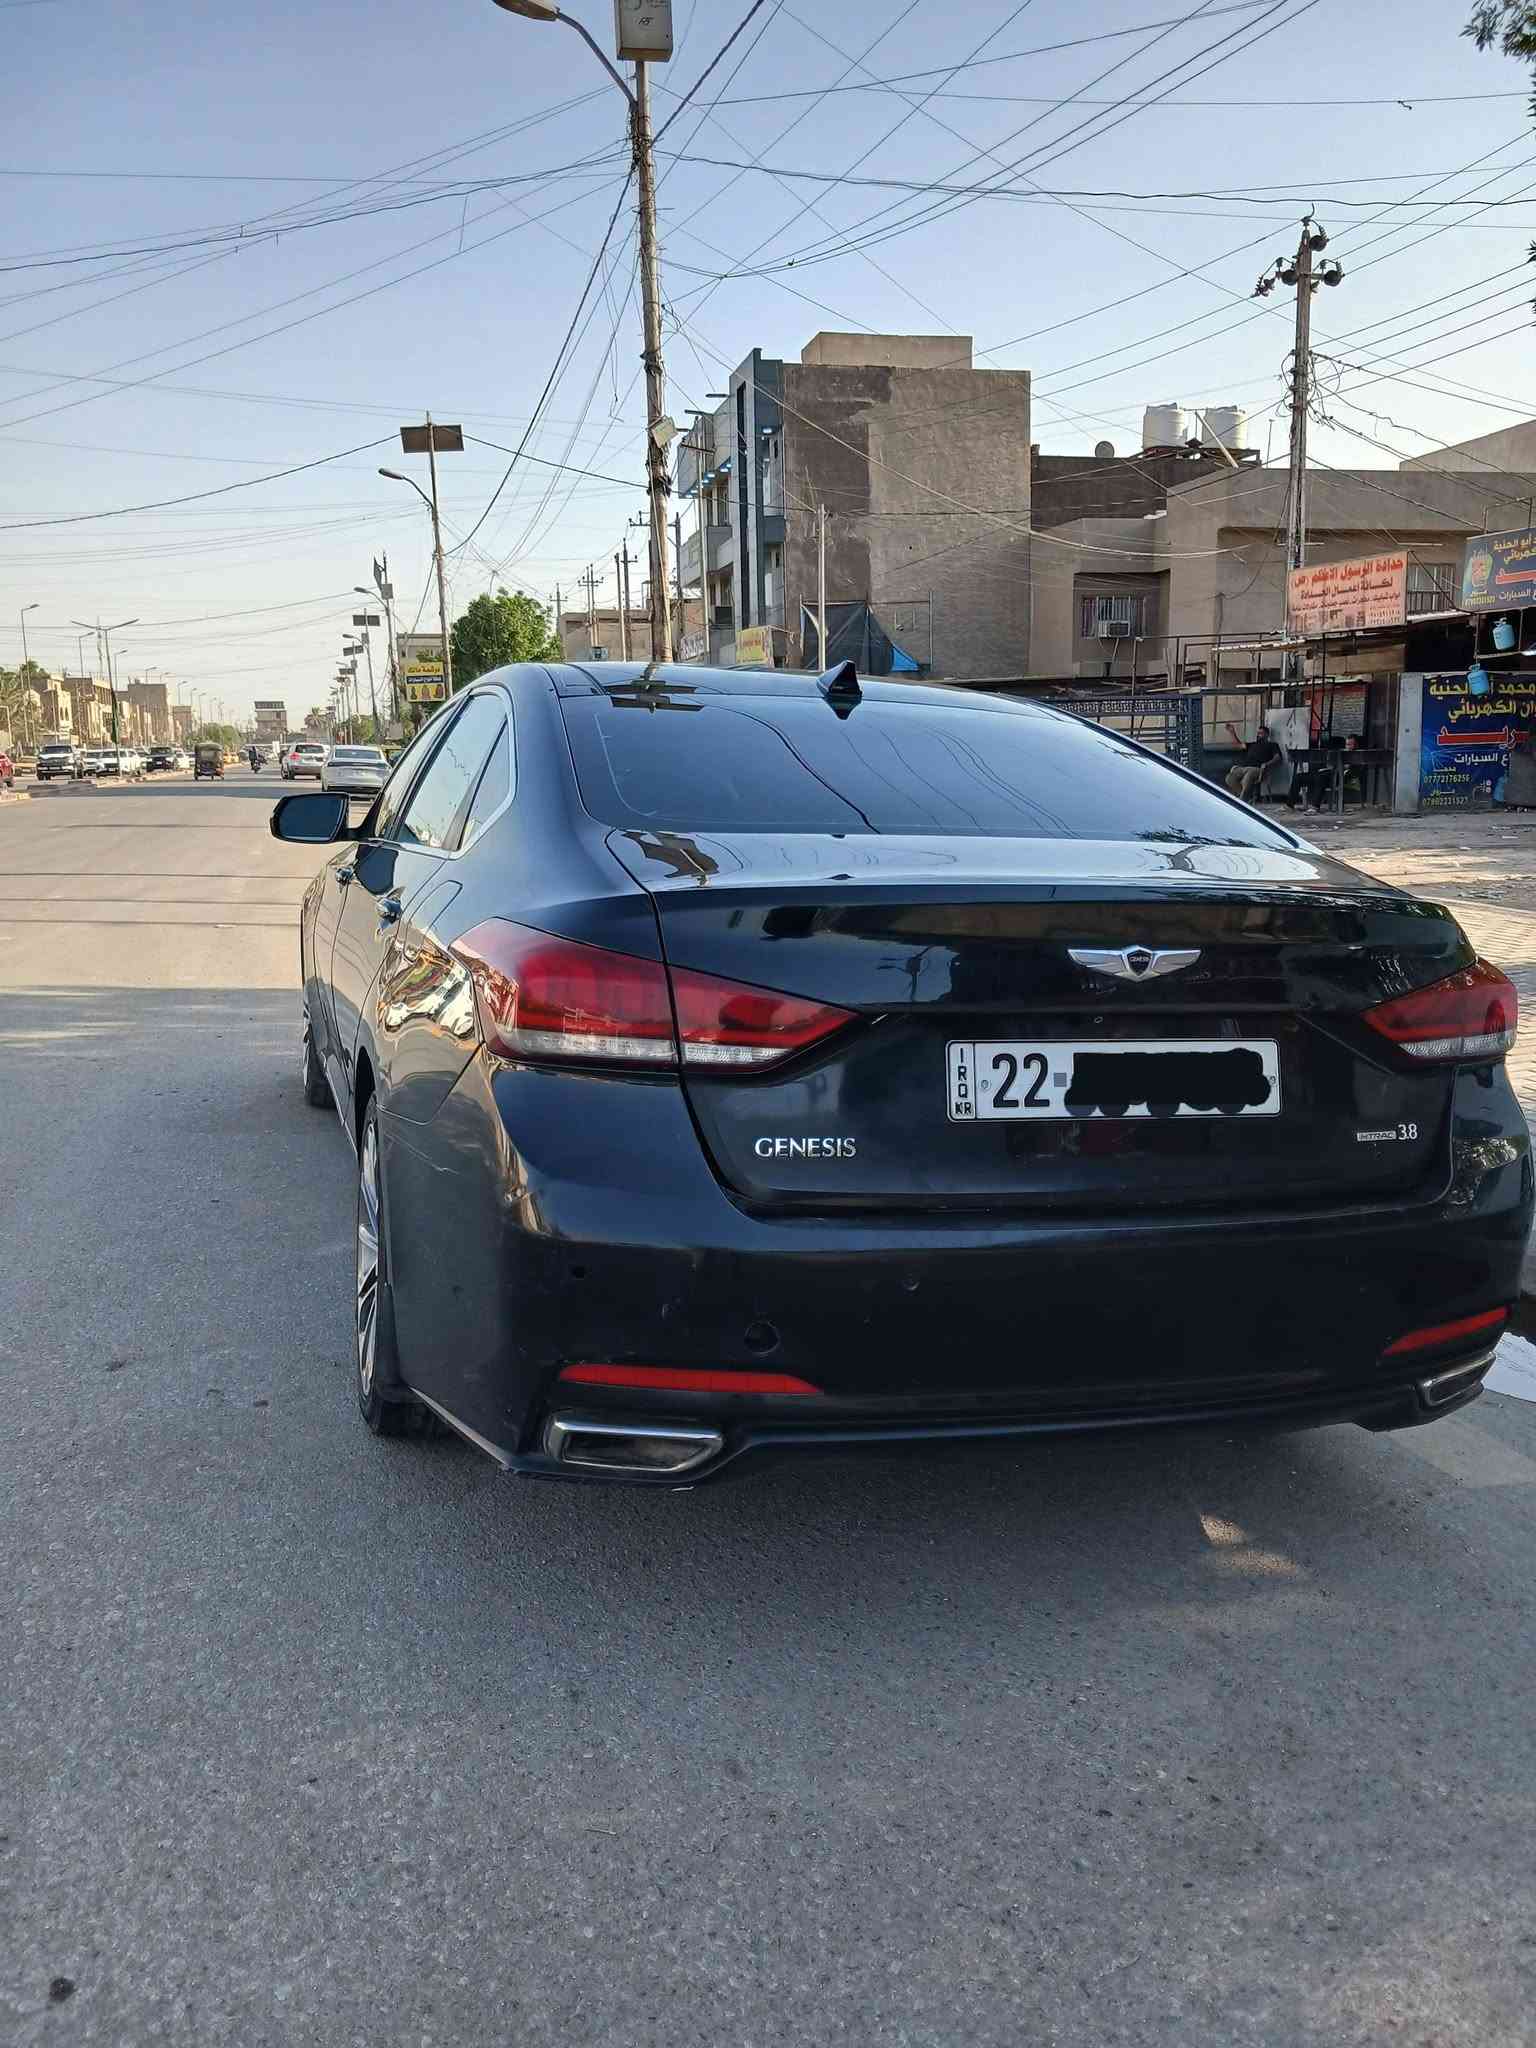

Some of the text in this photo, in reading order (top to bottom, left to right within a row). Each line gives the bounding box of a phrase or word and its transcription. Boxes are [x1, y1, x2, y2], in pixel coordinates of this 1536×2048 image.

[1499, 589, 1531, 601] السيارات
[1497, 682, 1536, 696] محمد
[1448, 698, 1517, 723] الكهربائي
[1454, 752, 1498, 766] السيارات
[992, 1053, 1050, 1108] 22
[754, 1137, 857, 1158] GENESIS
